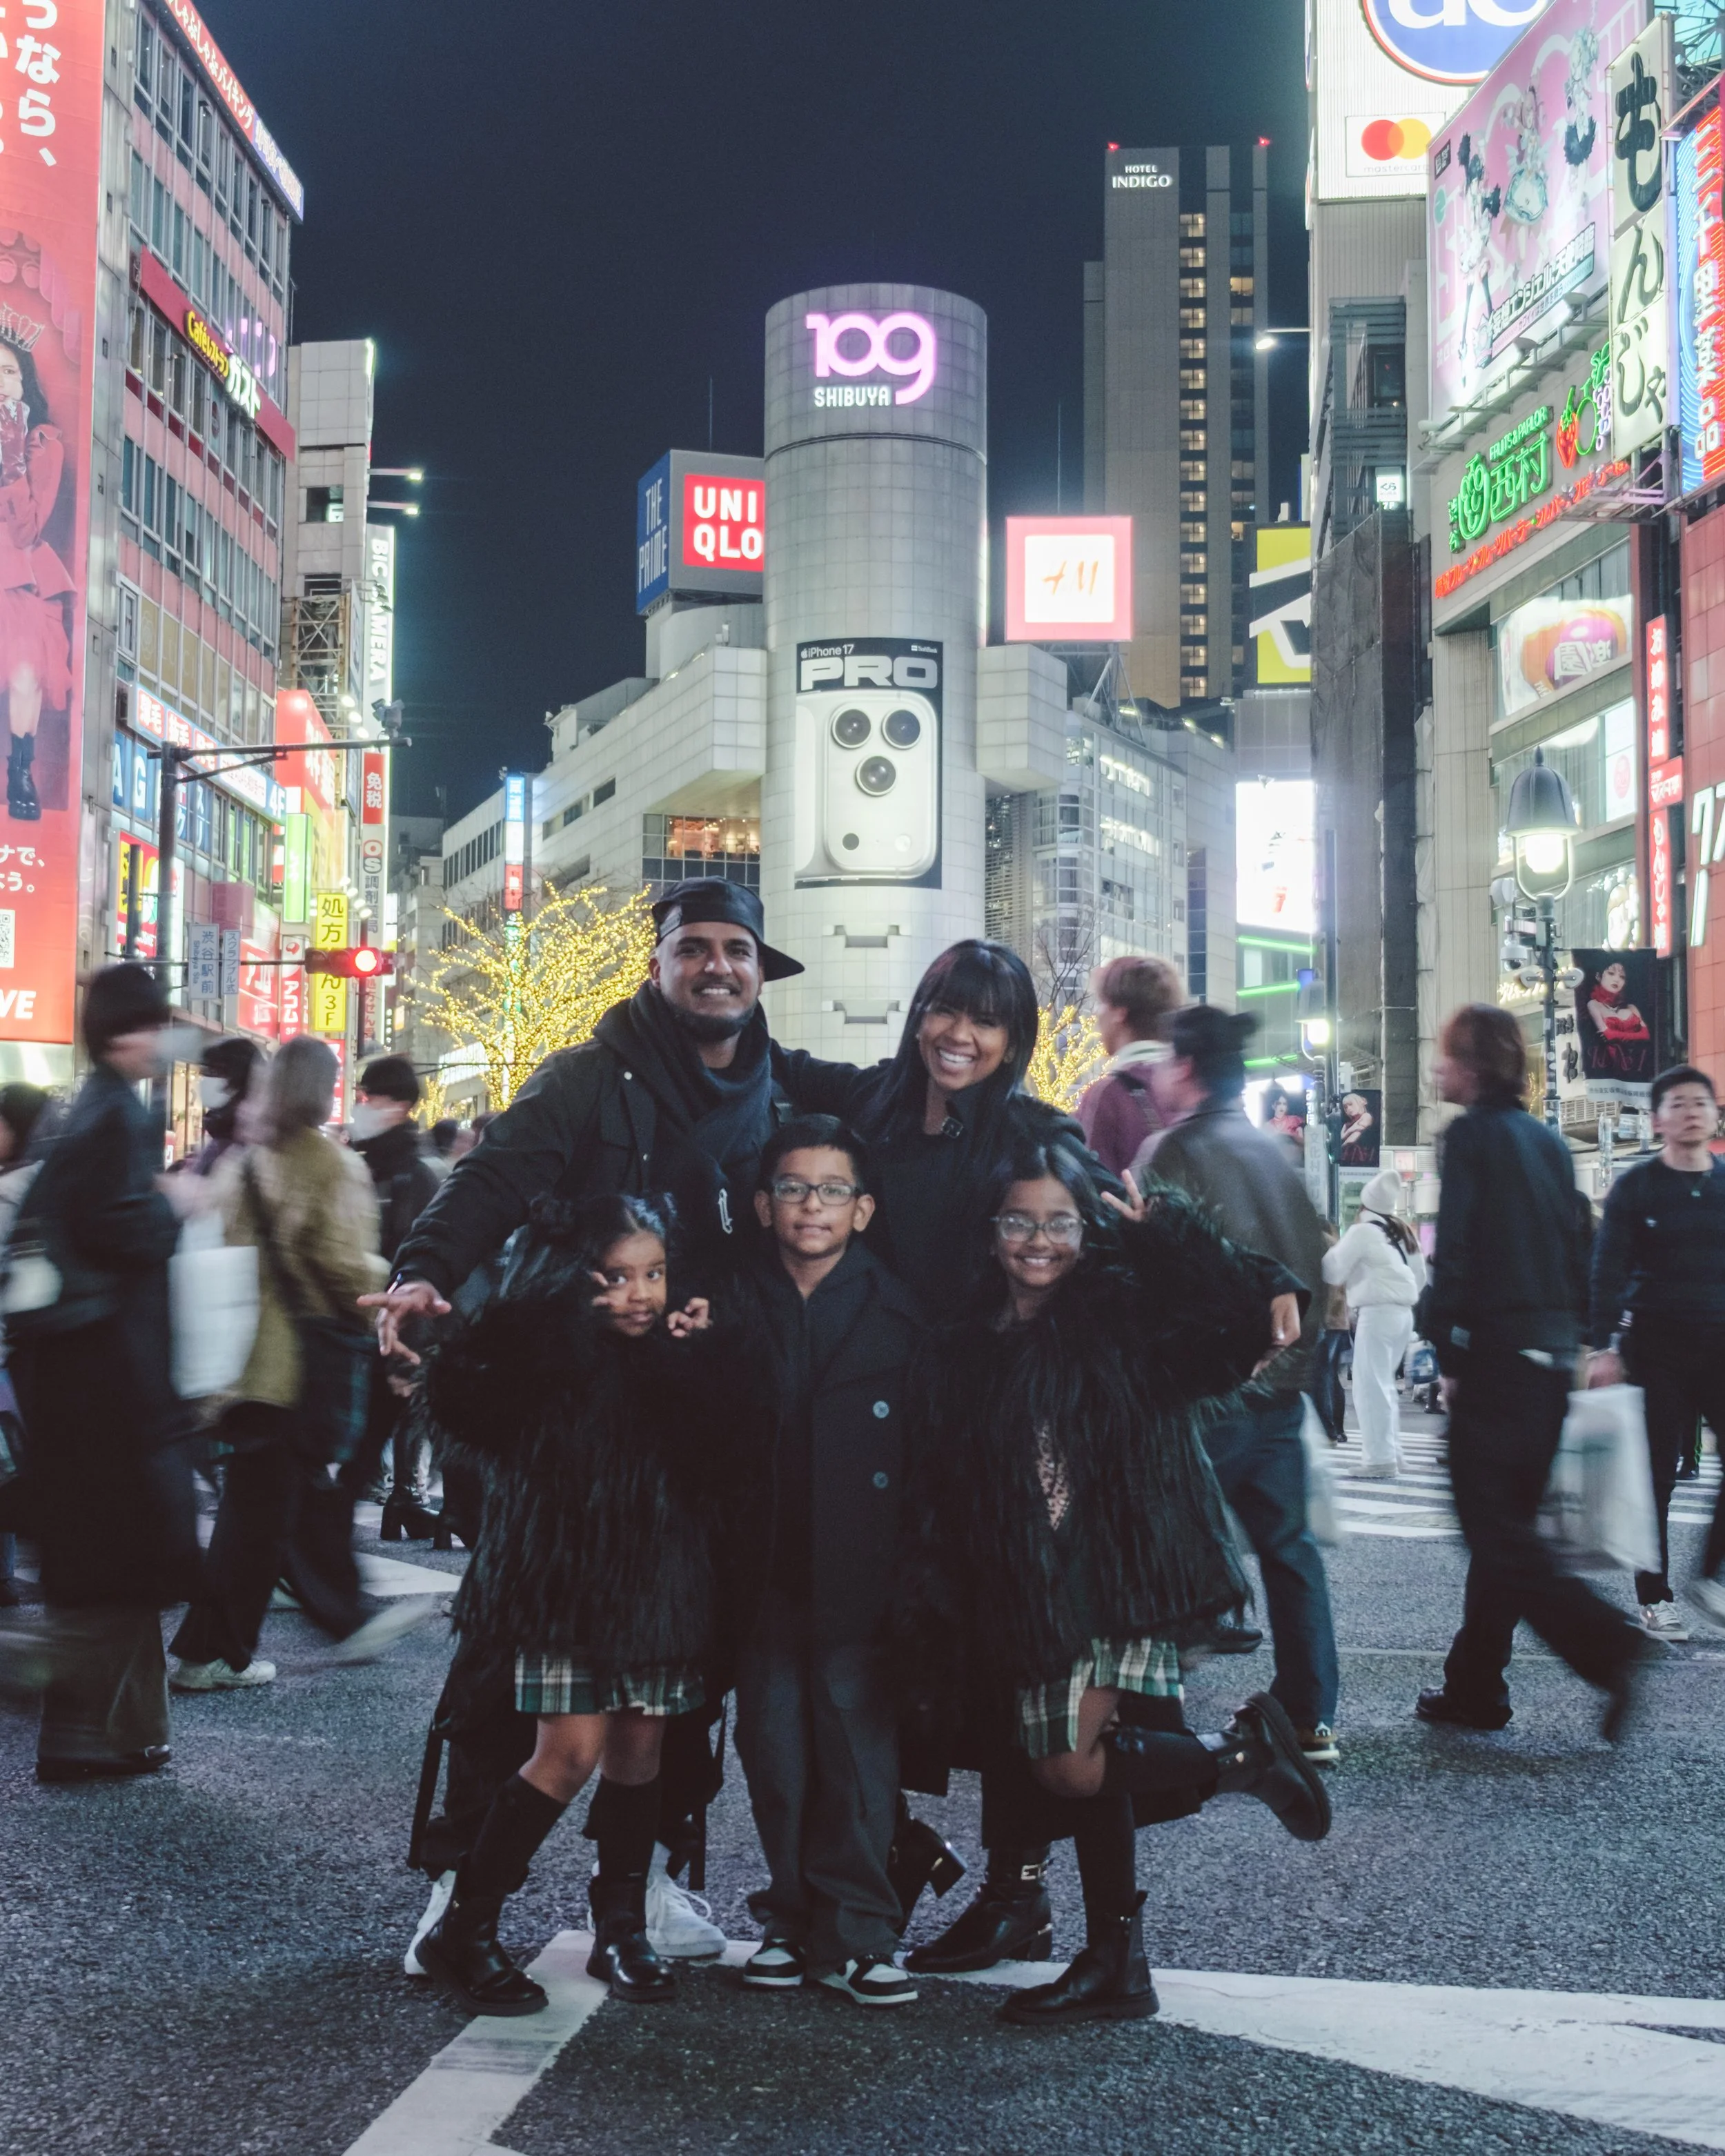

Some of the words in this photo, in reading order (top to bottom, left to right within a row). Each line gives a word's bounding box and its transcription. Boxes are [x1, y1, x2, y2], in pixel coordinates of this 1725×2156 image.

[1112, 175, 1172, 188] INDIGO
[1125, 165, 1157, 173] HOTEL
[1614, 52, 1666, 422] もんじゃ
[805, 312, 936, 405] 109
[814, 386, 890, 407] SHIBUYA
[1490, 431, 1548, 522] 西村
[645, 477, 662, 535] THE
[693, 486, 758, 524] UNI
[371, 538, 388, 578] BIC
[639, 525, 667, 593] PRIME
[693, 522, 763, 562] QLO
[808, 646, 841, 658] iPhone
[842, 644, 854, 655] 17
[801, 655, 938, 691] PRO
[366, 771, 382, 809] 免税
[363, 840, 382, 873] OS
[201, 931, 215, 993] 渋谷駅前
[321, 898, 344, 990] 処方ん
[284, 980, 299, 1023] アコム
[325, 994, 337, 1027] 3F
